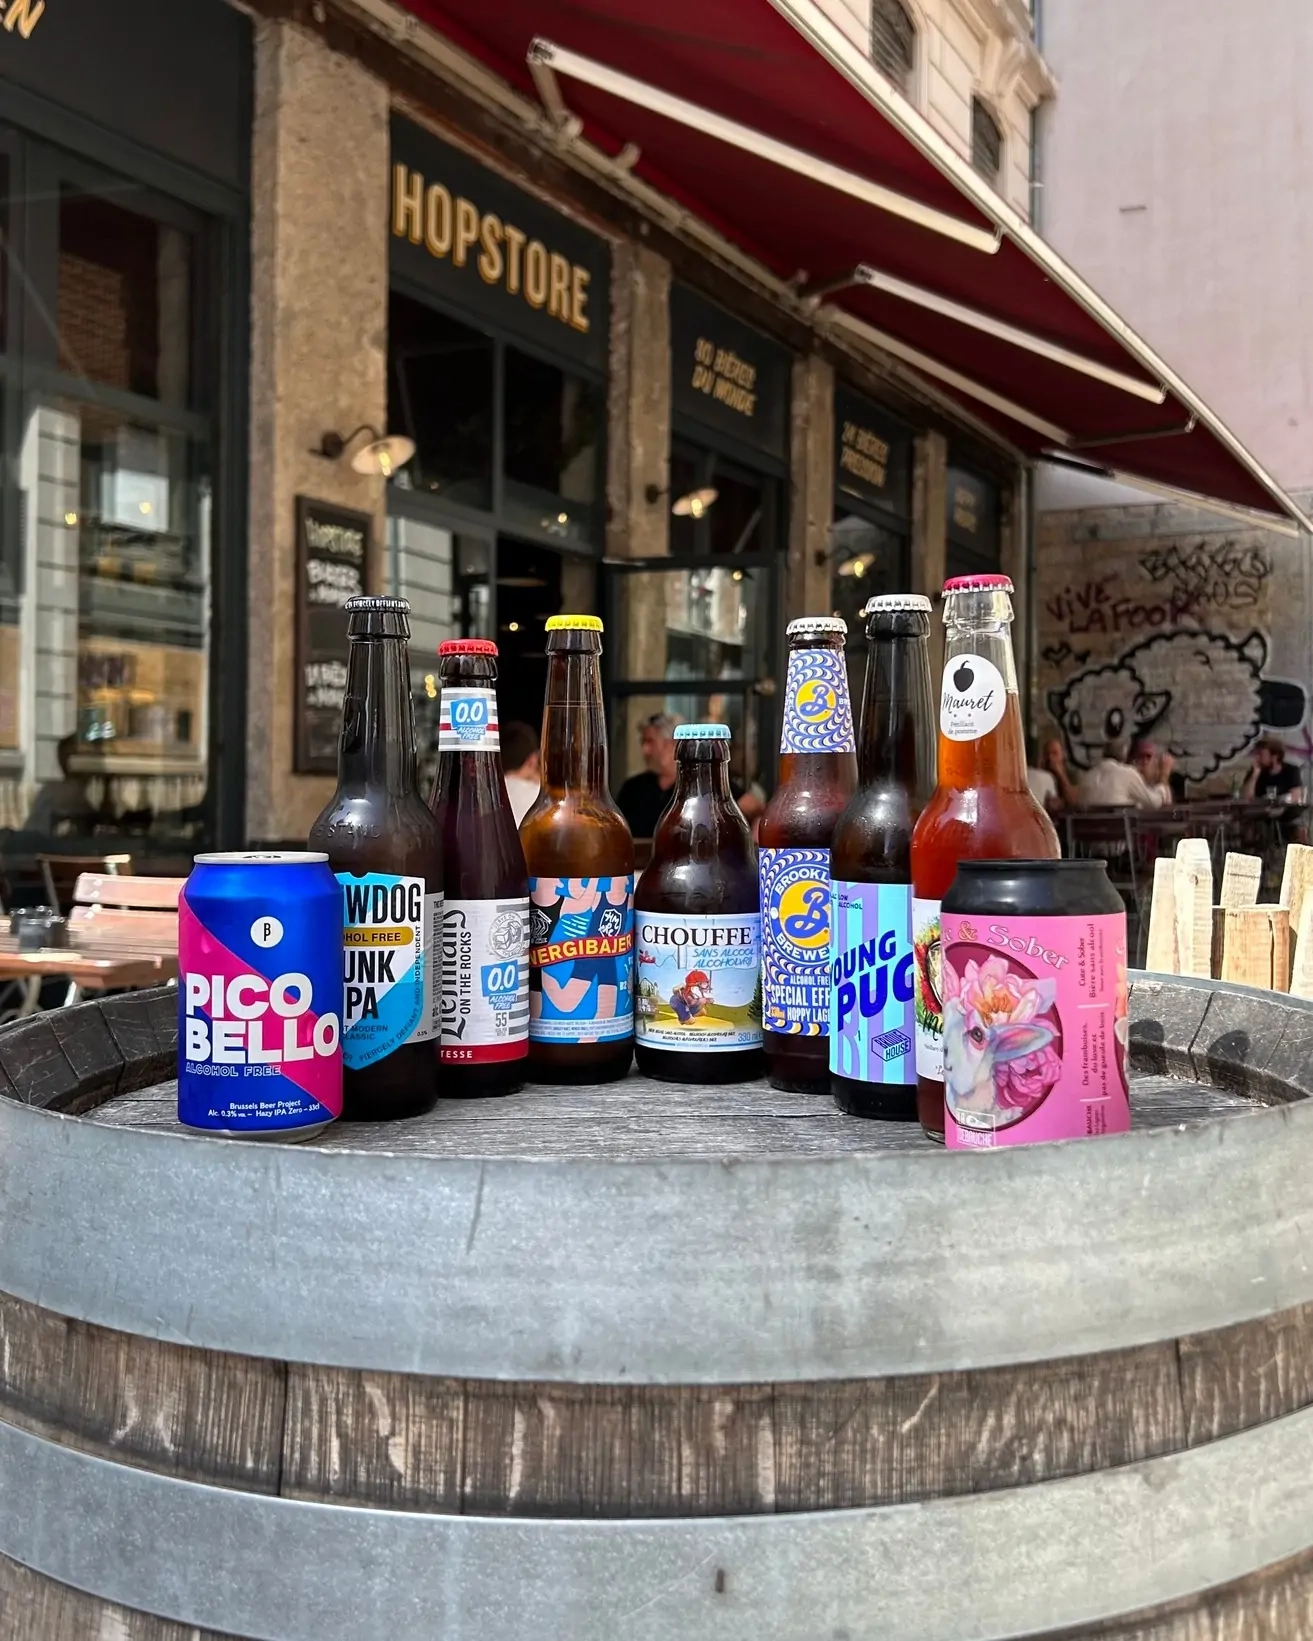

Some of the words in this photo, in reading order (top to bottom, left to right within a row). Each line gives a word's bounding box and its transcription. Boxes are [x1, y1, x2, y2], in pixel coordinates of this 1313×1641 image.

[393, 163, 592, 334] HOPSTORE
[942, 689, 994, 714] Mauret
[455, 701, 484, 723] 0.0
[838, 901, 863, 910] ALCOHOL
[343, 933, 368, 943] HOL
[372, 932, 402, 942] FREE
[642, 924, 752, 947] CHOUFFE
[1087, 924, 1095, 951] alcool
[460, 931, 472, 970] ROCKS
[692, 948, 719, 958] SANS
[723, 948, 754, 957] ALCOOL
[958, 921, 978, 941] &
[987, 924, 1070, 971] Sober
[1077, 937, 1086, 959] Sober
[460, 973, 472, 996] THE
[487, 964, 516, 992] 0.0
[789, 975, 816, 985] ALCOHOL
[1078, 968, 1086, 987] Cute
[186, 972, 313, 1020] PICO
[771, 985, 809, 1006] SPECIAL
[838, 951, 915, 1033] PUG
[346, 987, 379, 1020] PA
[460, 1001, 472, 1015] ON
[495, 1012, 508, 1028] 55
[787, 1007, 811, 1021] HOPPY
[351, 1024, 388, 1032] MODERN
[359, 1037, 396, 1062] FIERCELY
[396, 1008, 418, 1040] DEFIANT
[738, 1032, 751, 1042] 330
[1099, 1030, 1105, 1040] de
[186, 1012, 340, 1064] BELLO
[884, 1040, 909, 1060] HOUSE
[186, 1062, 239, 1077] ALCOHOL
[244, 1064, 282, 1077] FREE
[1091, 1066, 1098, 1074] du
[1100, 1070, 1106, 1080] de
[1101, 1082, 1109, 1096] pas
[208, 1109, 220, 1117] Alc.
[221, 1110, 237, 1118] 0.3%
[256, 1110, 273, 1118] Hazy
[274, 1108, 287, 1116] IPA
[288, 1106, 303, 1114] Zero
[309, 1103, 320, 1112] 33cl
[229, 1102, 259, 1110] Brussels
[278, 1100, 302, 1109] Project
